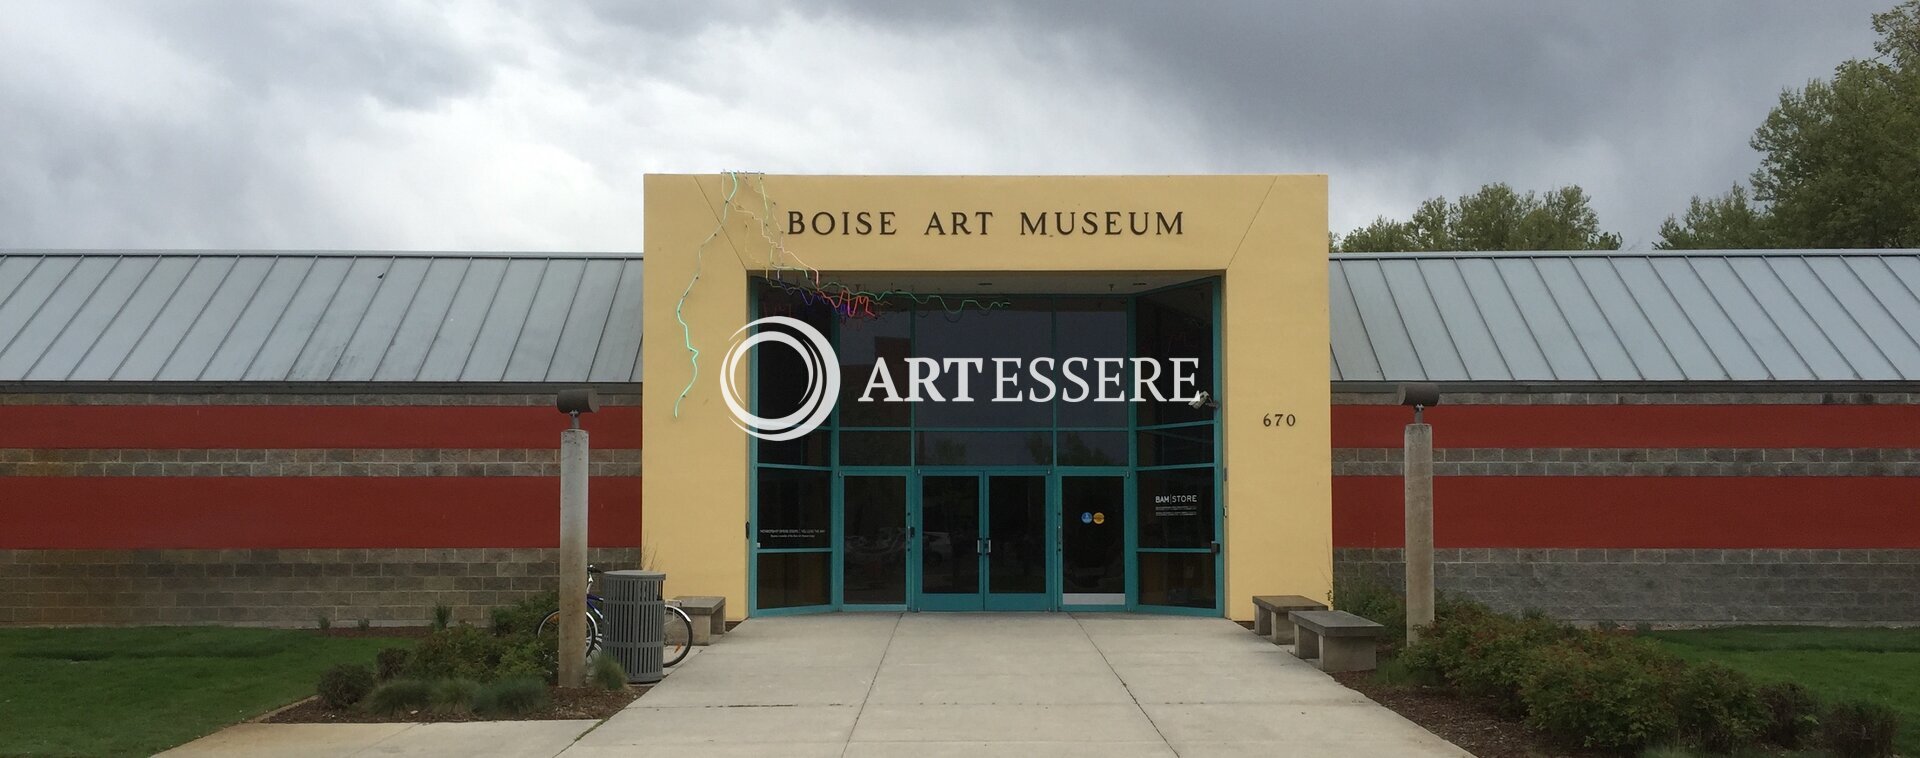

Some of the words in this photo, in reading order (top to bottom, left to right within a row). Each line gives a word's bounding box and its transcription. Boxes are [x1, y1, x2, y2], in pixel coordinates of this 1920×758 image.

[787, 211, 897, 236] BOISE
[924, 211, 993, 236] ART
[1019, 211, 1184, 236] MUSEUM
[1263, 413, 1296, 427] 670
